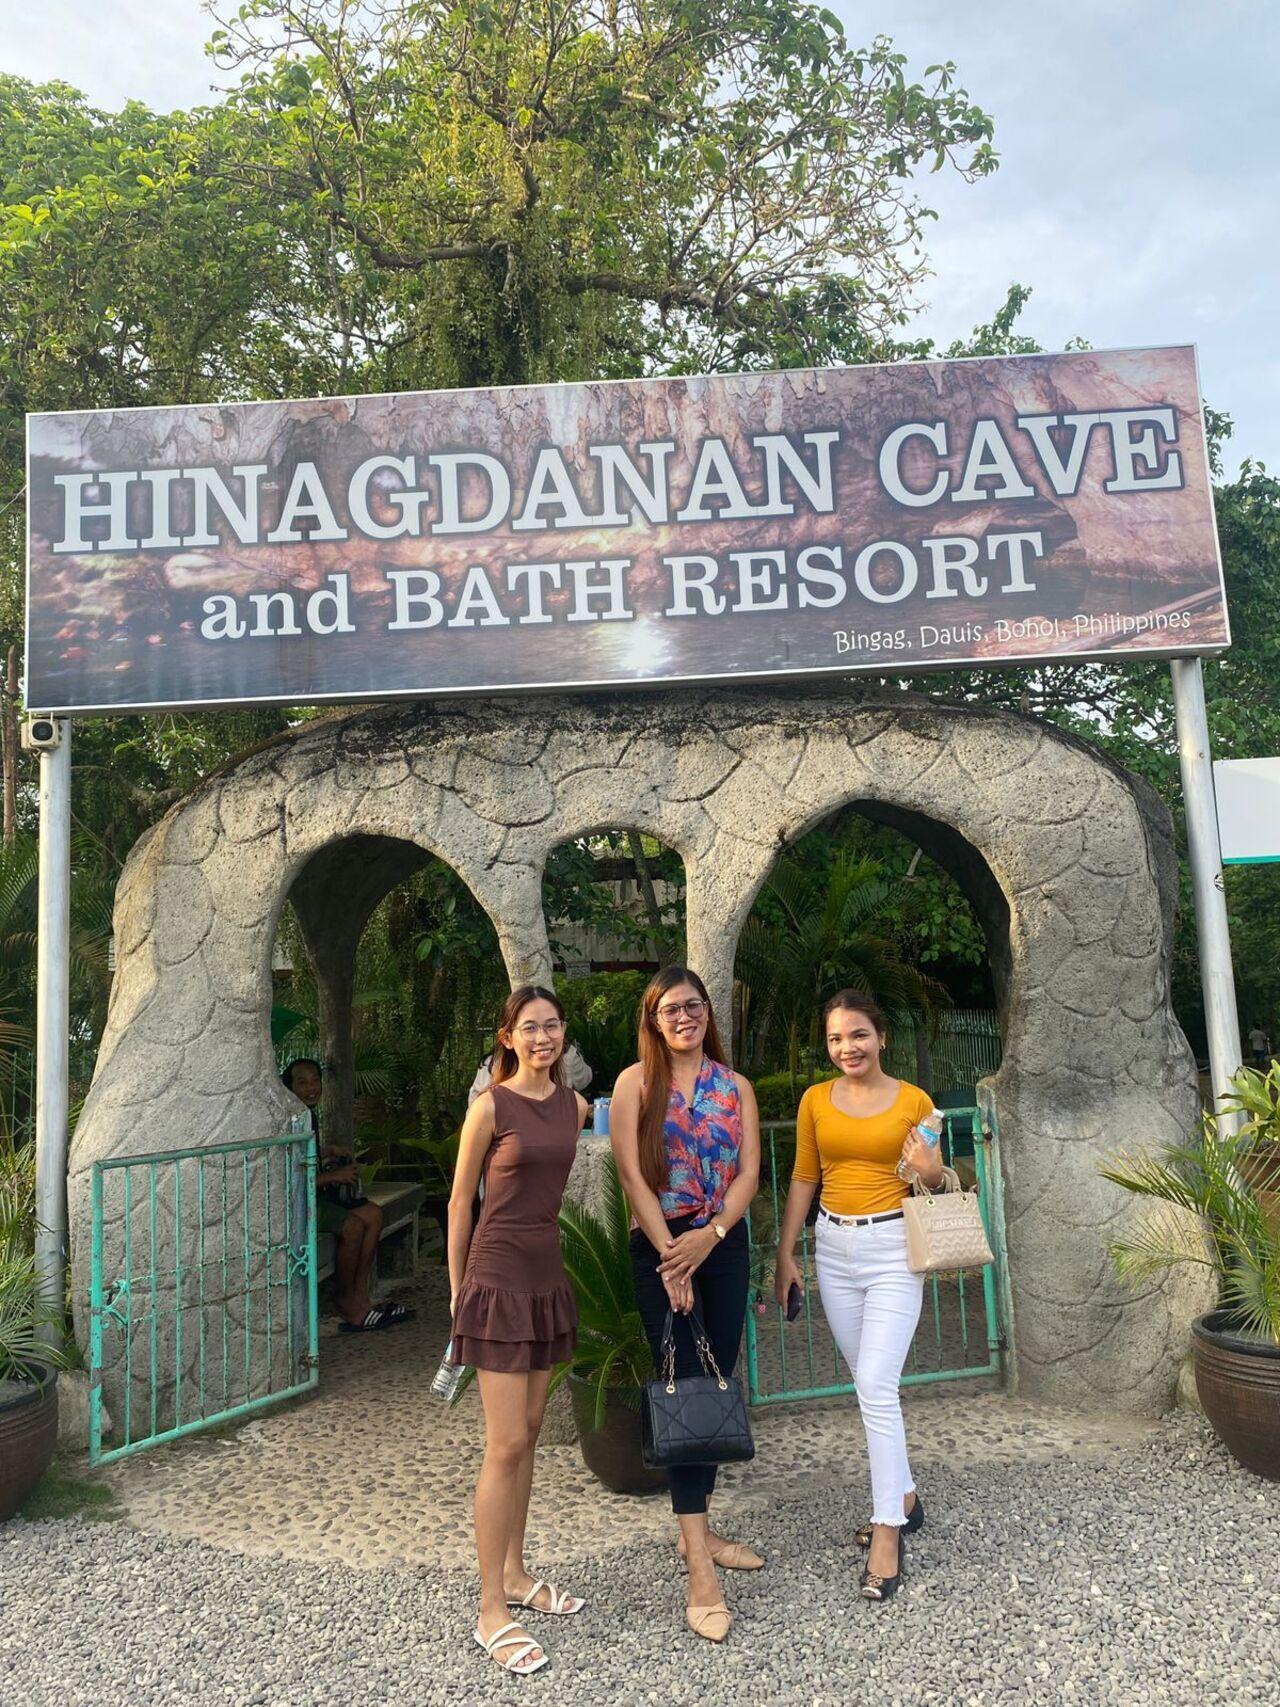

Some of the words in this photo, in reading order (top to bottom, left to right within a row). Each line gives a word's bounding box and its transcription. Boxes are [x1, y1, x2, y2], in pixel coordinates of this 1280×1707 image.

[53, 431, 840, 553] HINAGDANAN
[879, 408, 1182, 507] CAVE
[201, 573, 356, 640] and
[387, 559, 634, 630] BATH
[664, 531, 1043, 616] RESORT
[833, 630, 912, 653] Bingag,
[920, 622, 989, 648] Dauis,
[994, 618, 1066, 642] Bohol,
[1072, 610, 1191, 636] Philippines
